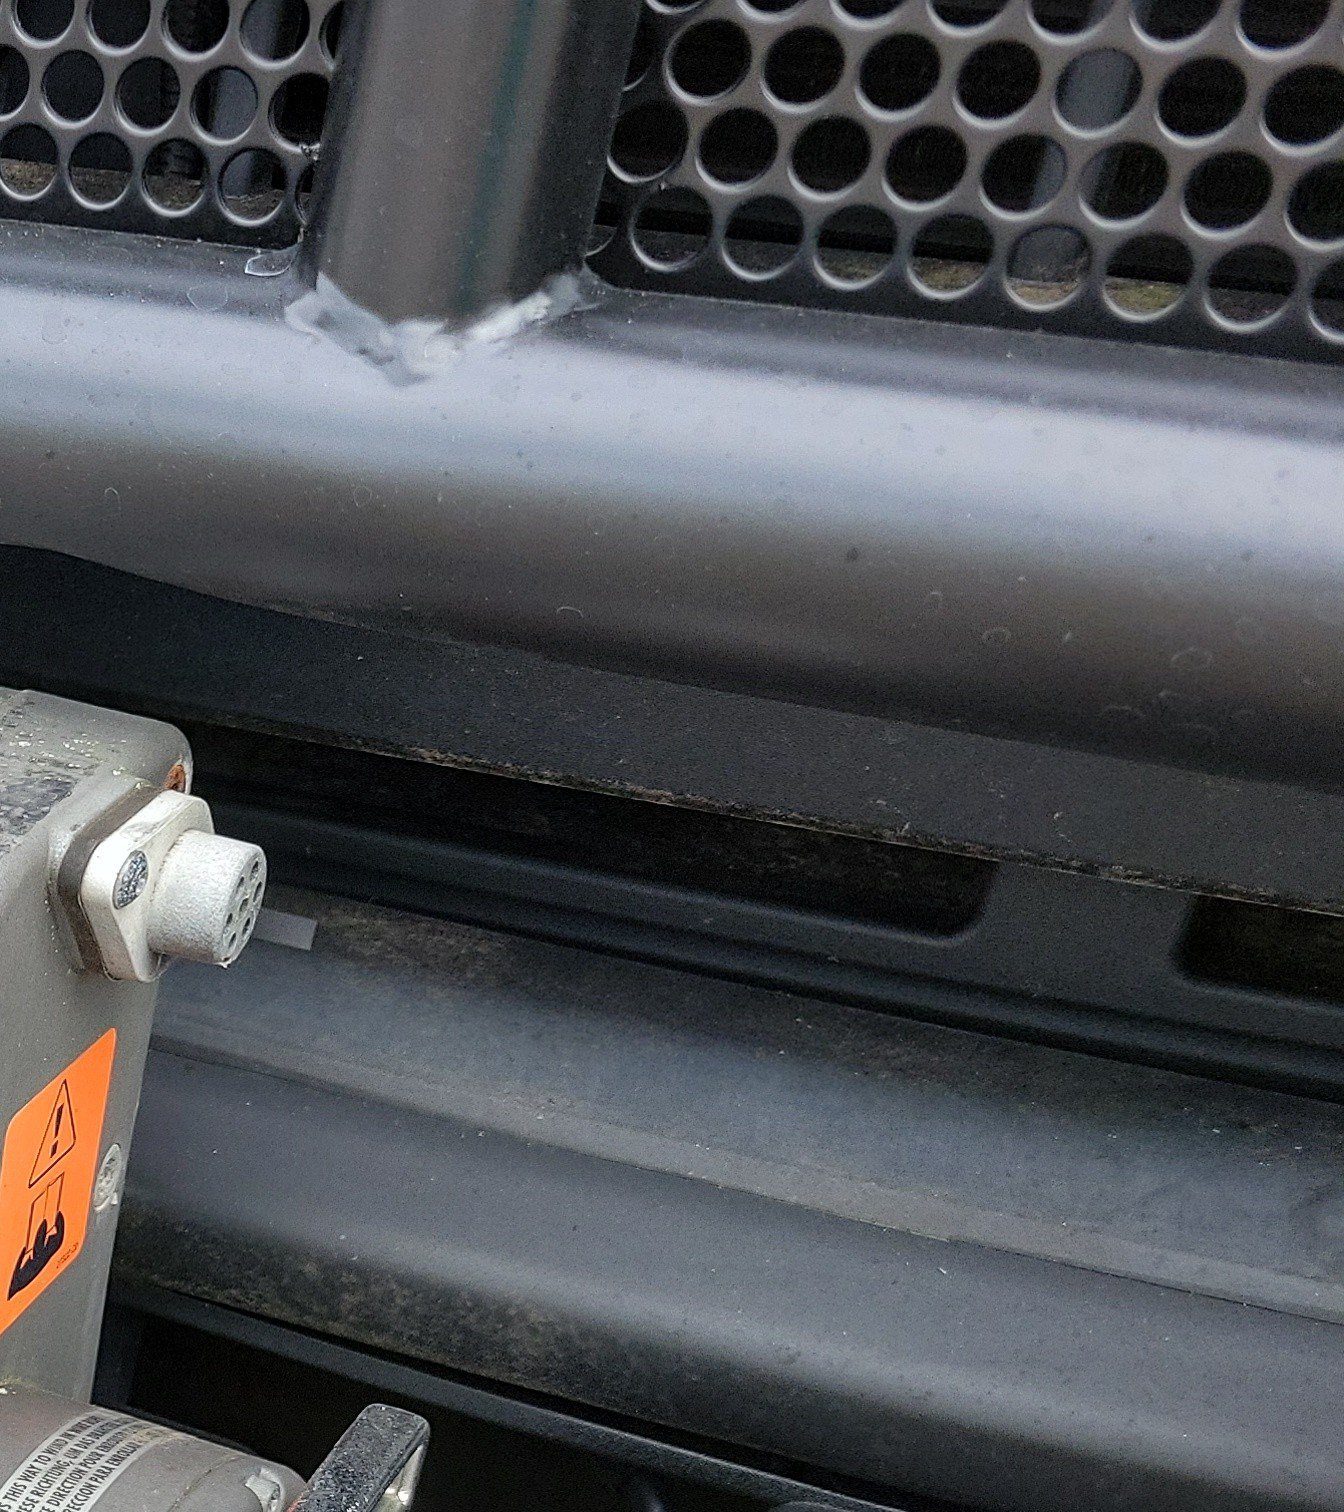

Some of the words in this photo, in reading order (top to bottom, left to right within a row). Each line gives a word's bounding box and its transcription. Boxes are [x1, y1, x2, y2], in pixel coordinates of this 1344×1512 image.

[4, 1480, 27, 1503] THIS
[17, 1463, 40, 1486] WAY
[33, 1451, 52, 1466] TO
[33, 1460, 73, 1498] RICHTUNG,
[49, 1468, 84, 1507] DIRECTION
[81, 1450, 104, 1472] POUR
[89, 1465, 113, 1487] PARA
